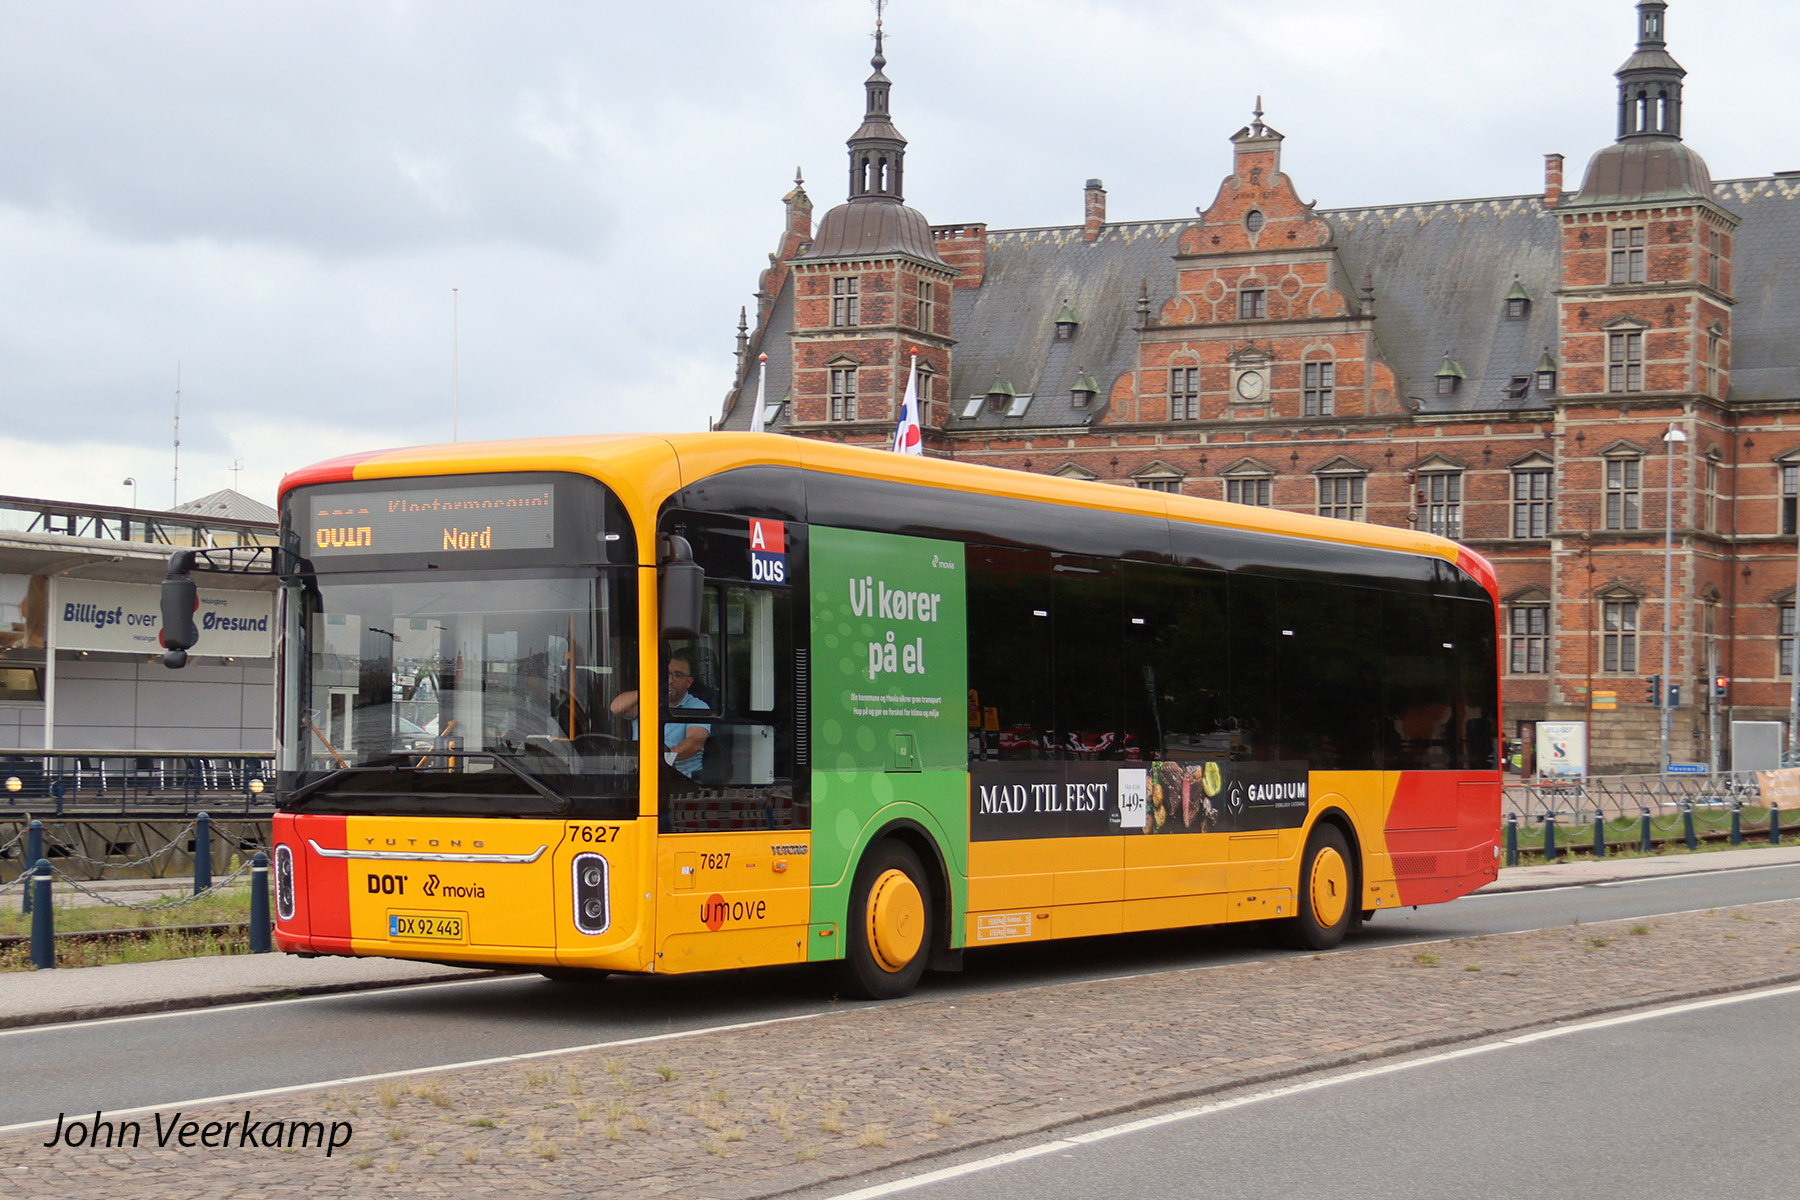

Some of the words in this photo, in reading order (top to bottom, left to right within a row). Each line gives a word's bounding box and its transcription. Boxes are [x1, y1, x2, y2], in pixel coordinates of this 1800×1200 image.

[443, 526, 491, 550] Nord
[751, 521, 766, 550] A
[751, 553, 784, 582] bus
[938, 560, 955, 570] movia
[850, 575, 873, 618] Vi
[878, 580, 941, 622] kører
[63, 602, 123, 629] Billigst
[127, 613, 157, 627] over
[202, 611, 268, 632] Øresund
[868, 630, 897, 680] på
[902, 637, 925, 674] el
[858, 694, 880, 702] kommune
[922, 696, 942, 704] transport
[979, 784, 1027, 815] MAD
[1031, 784, 1062, 813] TIL
[1065, 783, 1108, 811] FEST
[1248, 782, 1306, 801] GAUDIUM
[365, 837, 484, 848] YUTONG
[568, 825, 621, 843] 7627
[770, 845, 809, 856] YUTONG
[700, 853, 731, 869] 7627
[367, 873, 408, 895] DOT
[442, 882, 486, 899] movia
[700, 900, 766, 923] umove
[398, 918, 415, 934] DX
[418, 918, 433, 935] 92
[436, 919, 460, 936] 443
